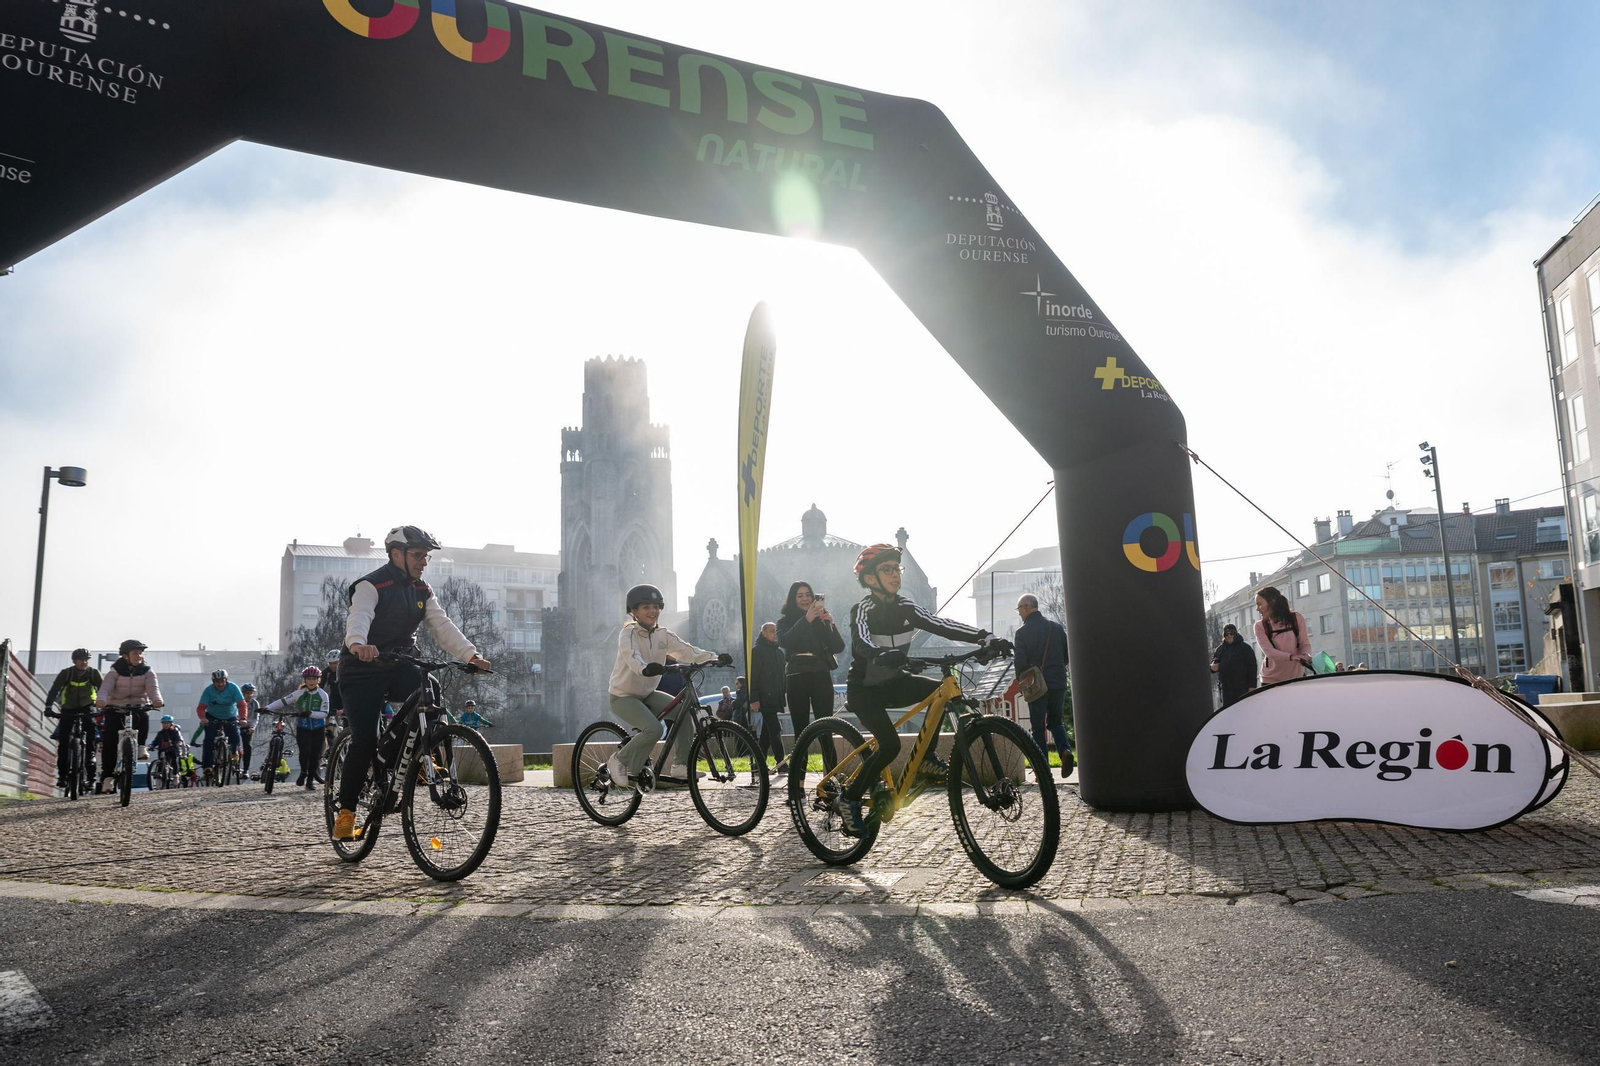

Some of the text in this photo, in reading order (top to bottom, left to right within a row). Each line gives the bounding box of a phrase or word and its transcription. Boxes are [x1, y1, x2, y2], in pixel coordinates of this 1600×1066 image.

[0, 32, 165, 91] EPUTACIÓN
[1, 53, 138, 105] OURENSE
[946, 232, 1037, 252] DEPUTACIÓN
[959, 248, 1029, 264] OURENSE
[1046, 299, 1093, 319] inorde
[1045, 324, 1087, 337] turismo
[1207, 727, 1515, 782] La Región
